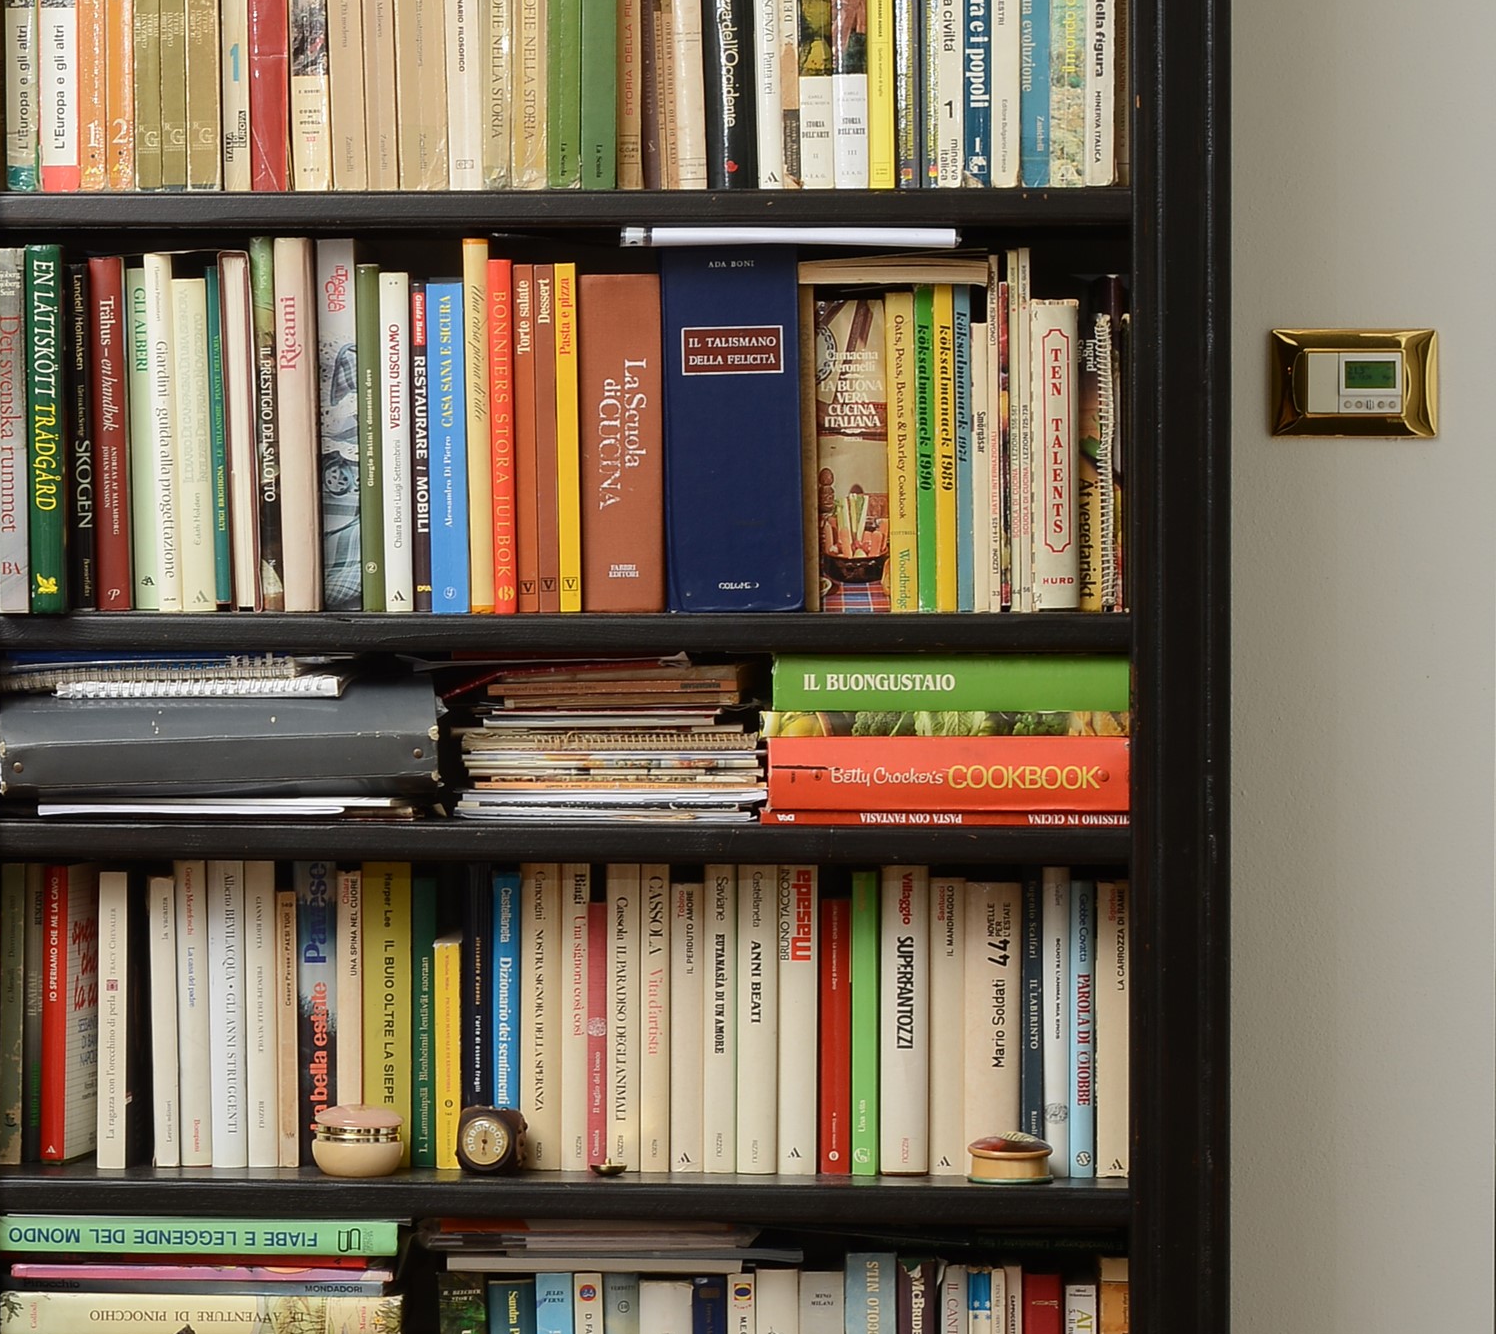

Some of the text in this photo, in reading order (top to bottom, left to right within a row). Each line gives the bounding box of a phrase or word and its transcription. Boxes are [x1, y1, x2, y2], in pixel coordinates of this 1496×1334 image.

[970, 21, 985, 32] e
[1094, 33, 1106, 77] figura
[54, 25, 67, 151] L'Europa e gli altri
[966, 48, 989, 108] popoli
[100, 297, 115, 346] Trähus
[134, 287, 148, 372] GLI ALBERI
[517, 280, 531, 355] Torte salate
[538, 278, 550, 324] Dessert
[280, 296, 301, 372] Ricami
[389, 323, 400, 379] USCIAMO
[440, 296, 453, 427] CASA SANA E SICURA
[689, 336, 776, 348] IL TALISMANO
[689, 351, 776, 366] DELLA FELICITÀ
[33, 260, 61, 511] EN LÄTTSKÖTT TRÄDGÅRD
[414, 357, 427, 459] RESTAURARE
[1051, 348, 1063, 534] TEN TALENTS
[75, 440, 92, 529] SKOGEN
[919, 451, 933, 492] 1990
[416, 477, 429, 533] MOBILI
[1043, 577, 1074, 585] HURD
[803, 673, 955, 691] IL BUONGUSTAIO
[831, 765, 1099, 789] Betty Crocker's COOKBOOK
[750, 940, 761, 1025] ANNI BEATI
[897, 935, 914, 1050] SUPERFANTOZZI
[383, 940, 395, 1105] IL BUIO OLTRE LA SIEPE
[992, 979, 1005, 1069] Mario Soldati
[9, 1227, 317, 1247] FIABE E LEGGENDE DEL MONDO
